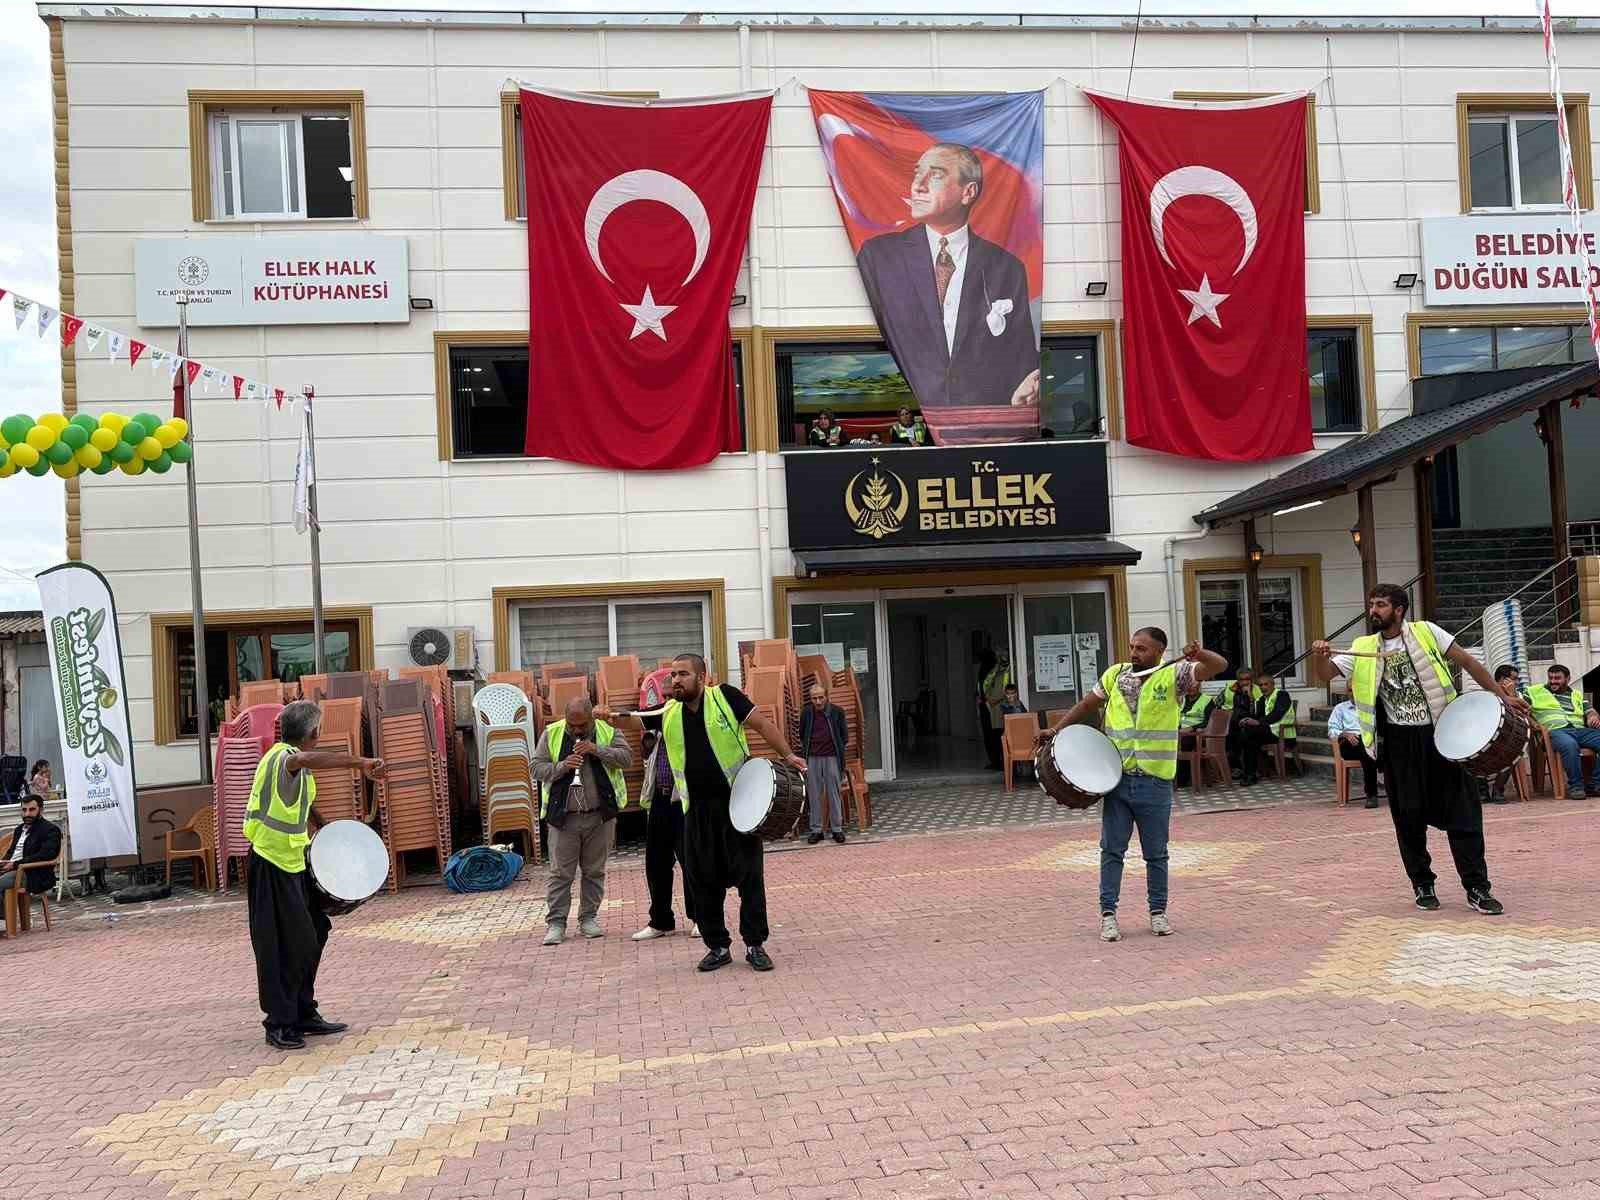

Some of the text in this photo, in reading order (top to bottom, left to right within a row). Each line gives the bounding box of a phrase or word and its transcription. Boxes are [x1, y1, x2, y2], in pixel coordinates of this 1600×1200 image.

[1475, 228, 1596, 256] BELEDİYE
[264, 260, 377, 277] ELLEK HALK
[1433, 262, 1528, 290] DÜĞÜN
[253, 281, 388, 301] KÜTÜPHANESİ
[971, 460, 1000, 473] T.C.
[917, 473, 1057, 510] ELLEK
[919, 508, 1057, 531] BELEDİYESİ
